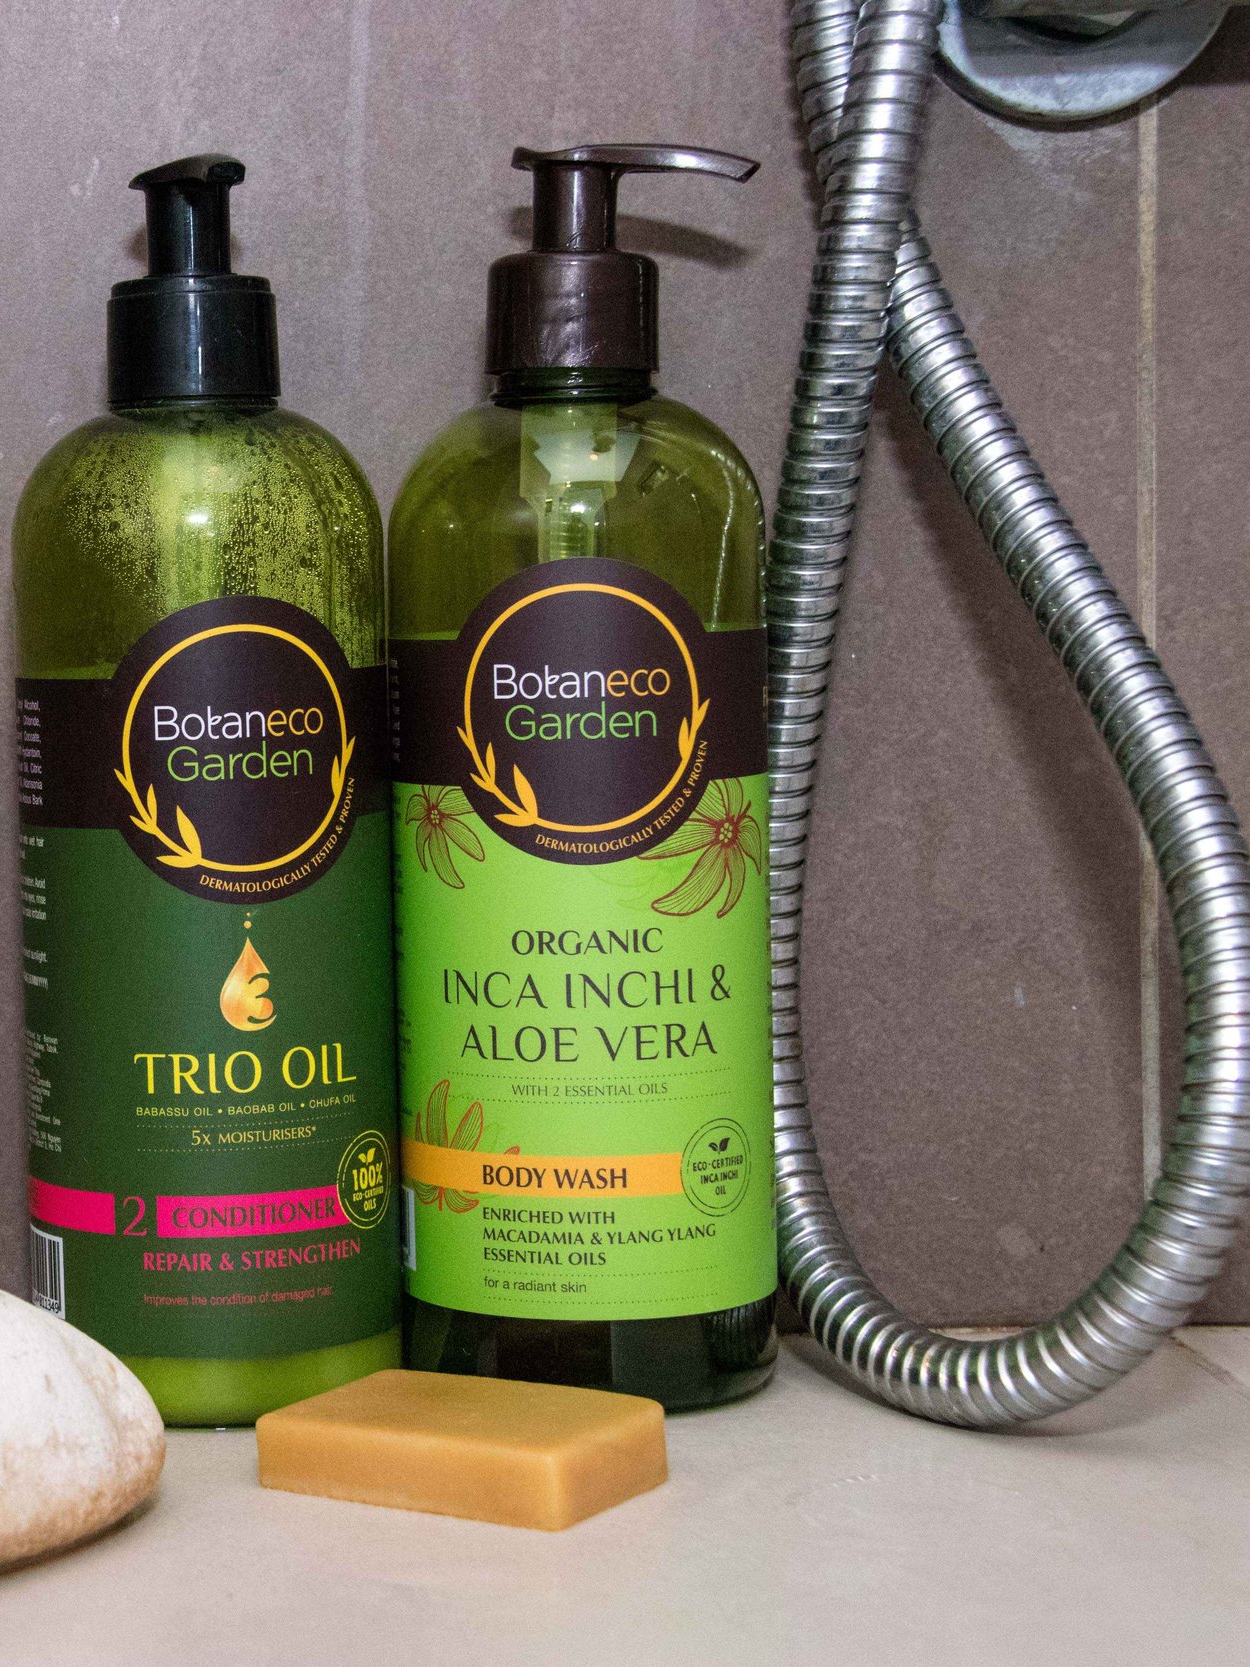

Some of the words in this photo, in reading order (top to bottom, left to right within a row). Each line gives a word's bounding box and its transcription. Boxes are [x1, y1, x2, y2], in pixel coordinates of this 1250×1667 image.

[493, 664, 670, 699] Botaneco
[154, 706, 323, 740] Botaneco
[505, 702, 657, 740] Garden
[167, 741, 313, 782] Garden
[687, 740, 708, 787] PROVEN
[683, 788, 692, 798] &
[653, 797, 685, 830] TESTED
[200, 863, 312, 893] DERMATOLOGICALLY
[311, 834, 338, 867] TESTED
[335, 825, 343, 834] &
[339, 777, 355, 823] PROVEN
[535, 826, 653, 853] DERMATOLOGICALLY
[511, 928, 663, 955] ORGANIC
[444, 969, 548, 1008] INCA
[565, 968, 696, 1008] INCHI
[710, 964, 731, 1001] &
[461, 1024, 579, 1062] ALOE
[594, 1021, 717, 1062] VERA
[134, 1051, 262, 1094] TRIO
[282, 1042, 357, 1089] OIL
[512, 1084, 548, 1097] WITH
[552, 1086, 560, 1097] 2
[565, 1084, 633, 1097] ESSENTIAL
[638, 1082, 668, 1095] OILS
[136, 1107, 189, 1116] BABASSU
[194, 1106, 213, 1116] OIL
[228, 1104, 275, 1115] BAOBAB
[279, 1102, 296, 1112] OIL
[309, 1096, 340, 1109] CHUFA
[343, 1094, 357, 1104] OIL
[352, 1161, 383, 1191] 100%
[483, 1164, 546, 1188] BODY
[554, 1168, 627, 1189] WASH
[701, 1174, 719, 1184] INCA
[720, 1170, 738, 1181] INCHI
[715, 1185, 726, 1195] OIL
[123, 1196, 148, 1236] 2
[172, 1197, 336, 1229] CONDITIONER
[364, 1198, 377, 1211] OILS
[483, 1207, 563, 1224] ENRICHED
[568, 1211, 615, 1224] WITH
[483, 1228, 585, 1245] MACADAMIA
[590, 1232, 603, 1245] &
[608, 1230, 663, 1245] YLANG
[667, 1223, 716, 1243] YLANG
[143, 1253, 213, 1271] REPAIR
[219, 1253, 234, 1271] &
[241, 1238, 361, 1271] STRENGTHEN
[484, 1248, 563, 1265] ESSENTIAL
[568, 1252, 607, 1265] OILS
[192, 1295, 207, 1306] the
[210, 1293, 253, 1305] condition
[259, 1292, 268, 1303] of
[272, 1288, 315, 1302] damaged
[484, 1276, 499, 1288] for
[502, 1280, 510, 1289] a
[513, 1279, 556, 1293] radiant
[561, 1281, 587, 1293] skin
